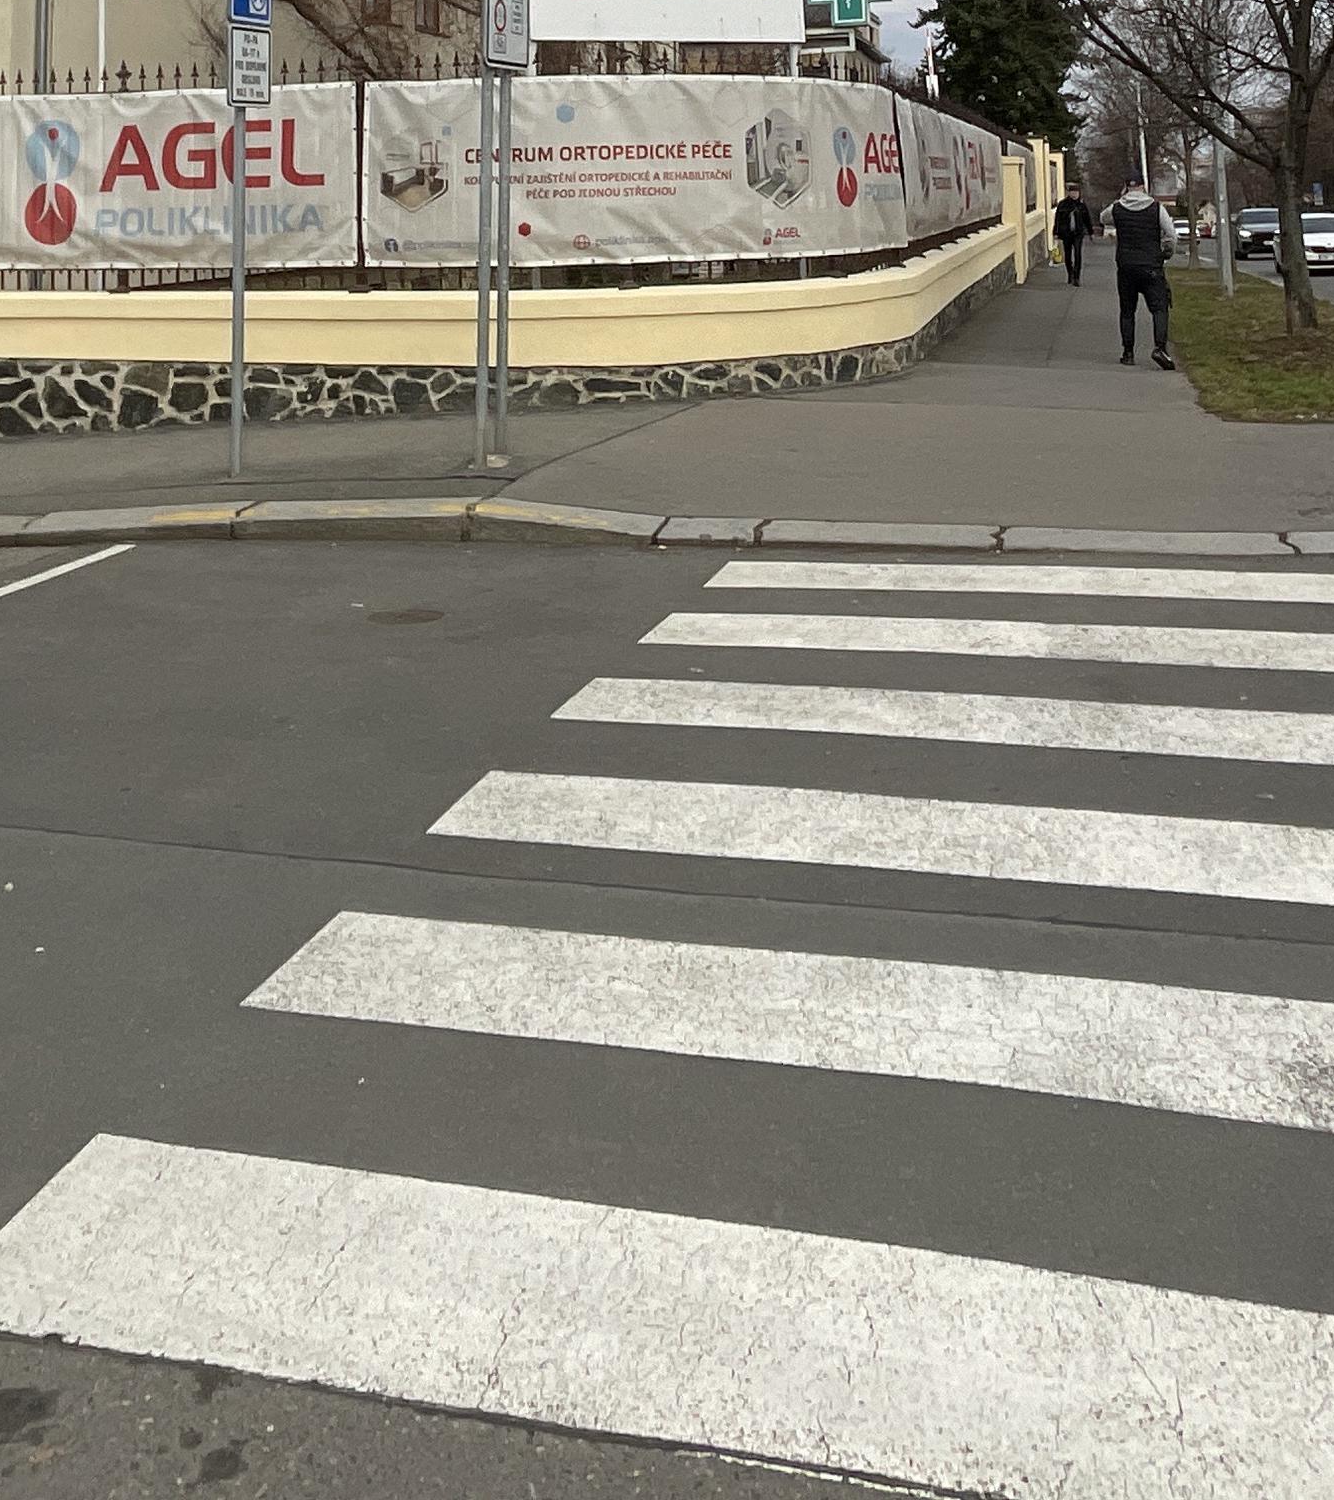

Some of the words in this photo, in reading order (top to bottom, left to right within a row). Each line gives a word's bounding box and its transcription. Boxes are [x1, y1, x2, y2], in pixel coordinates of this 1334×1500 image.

[99, 118, 325, 192] AGEL
[465, 148, 554, 164] CENRUM
[559, 142, 687, 161] ORTOPEDICKÉ
[691, 141, 733, 159] PÉČE
[863, 131, 901, 174] AGE
[653, 172, 661, 181] A
[553, 188, 576, 199] POD
